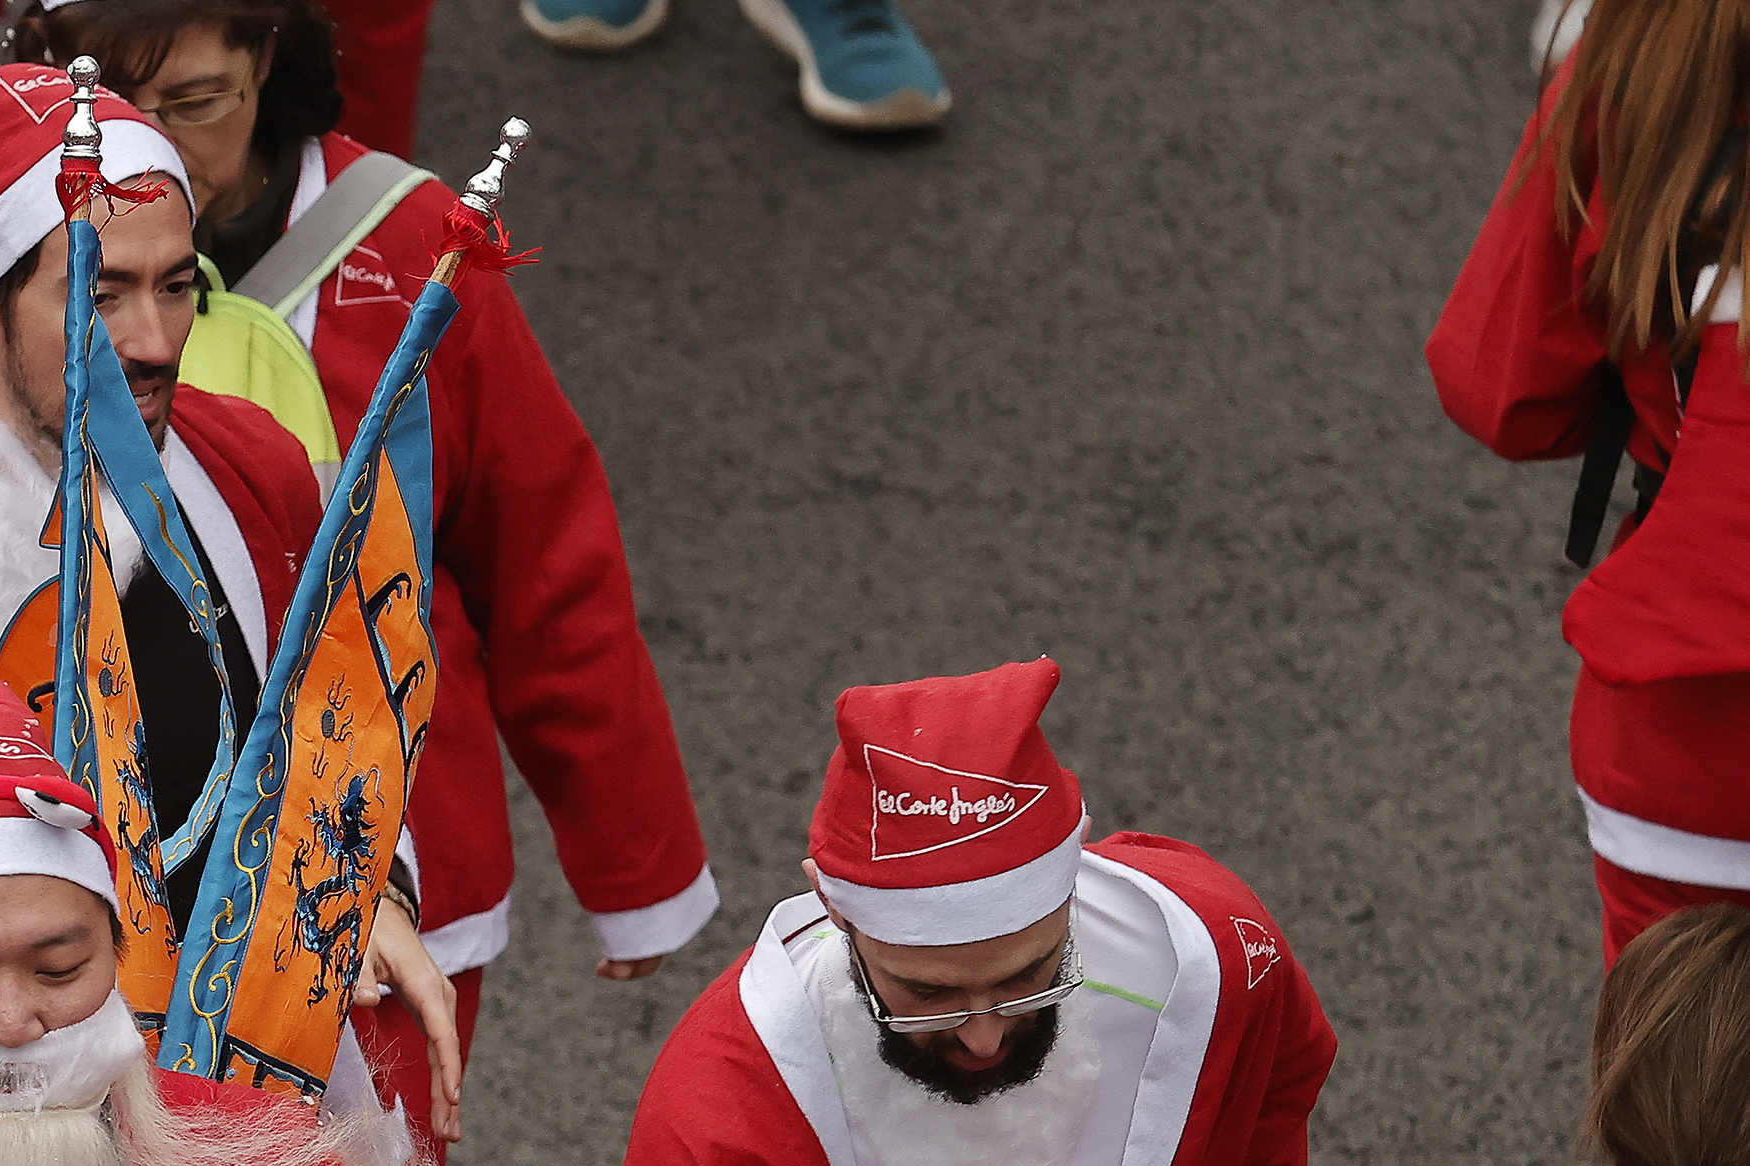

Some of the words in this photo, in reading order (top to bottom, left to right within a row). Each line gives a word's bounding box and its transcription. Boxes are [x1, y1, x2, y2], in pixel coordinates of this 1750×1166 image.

[878, 790, 897, 814] El
[896, 792, 948, 816] Corte
[949, 786, 1016, 825] Inglés
